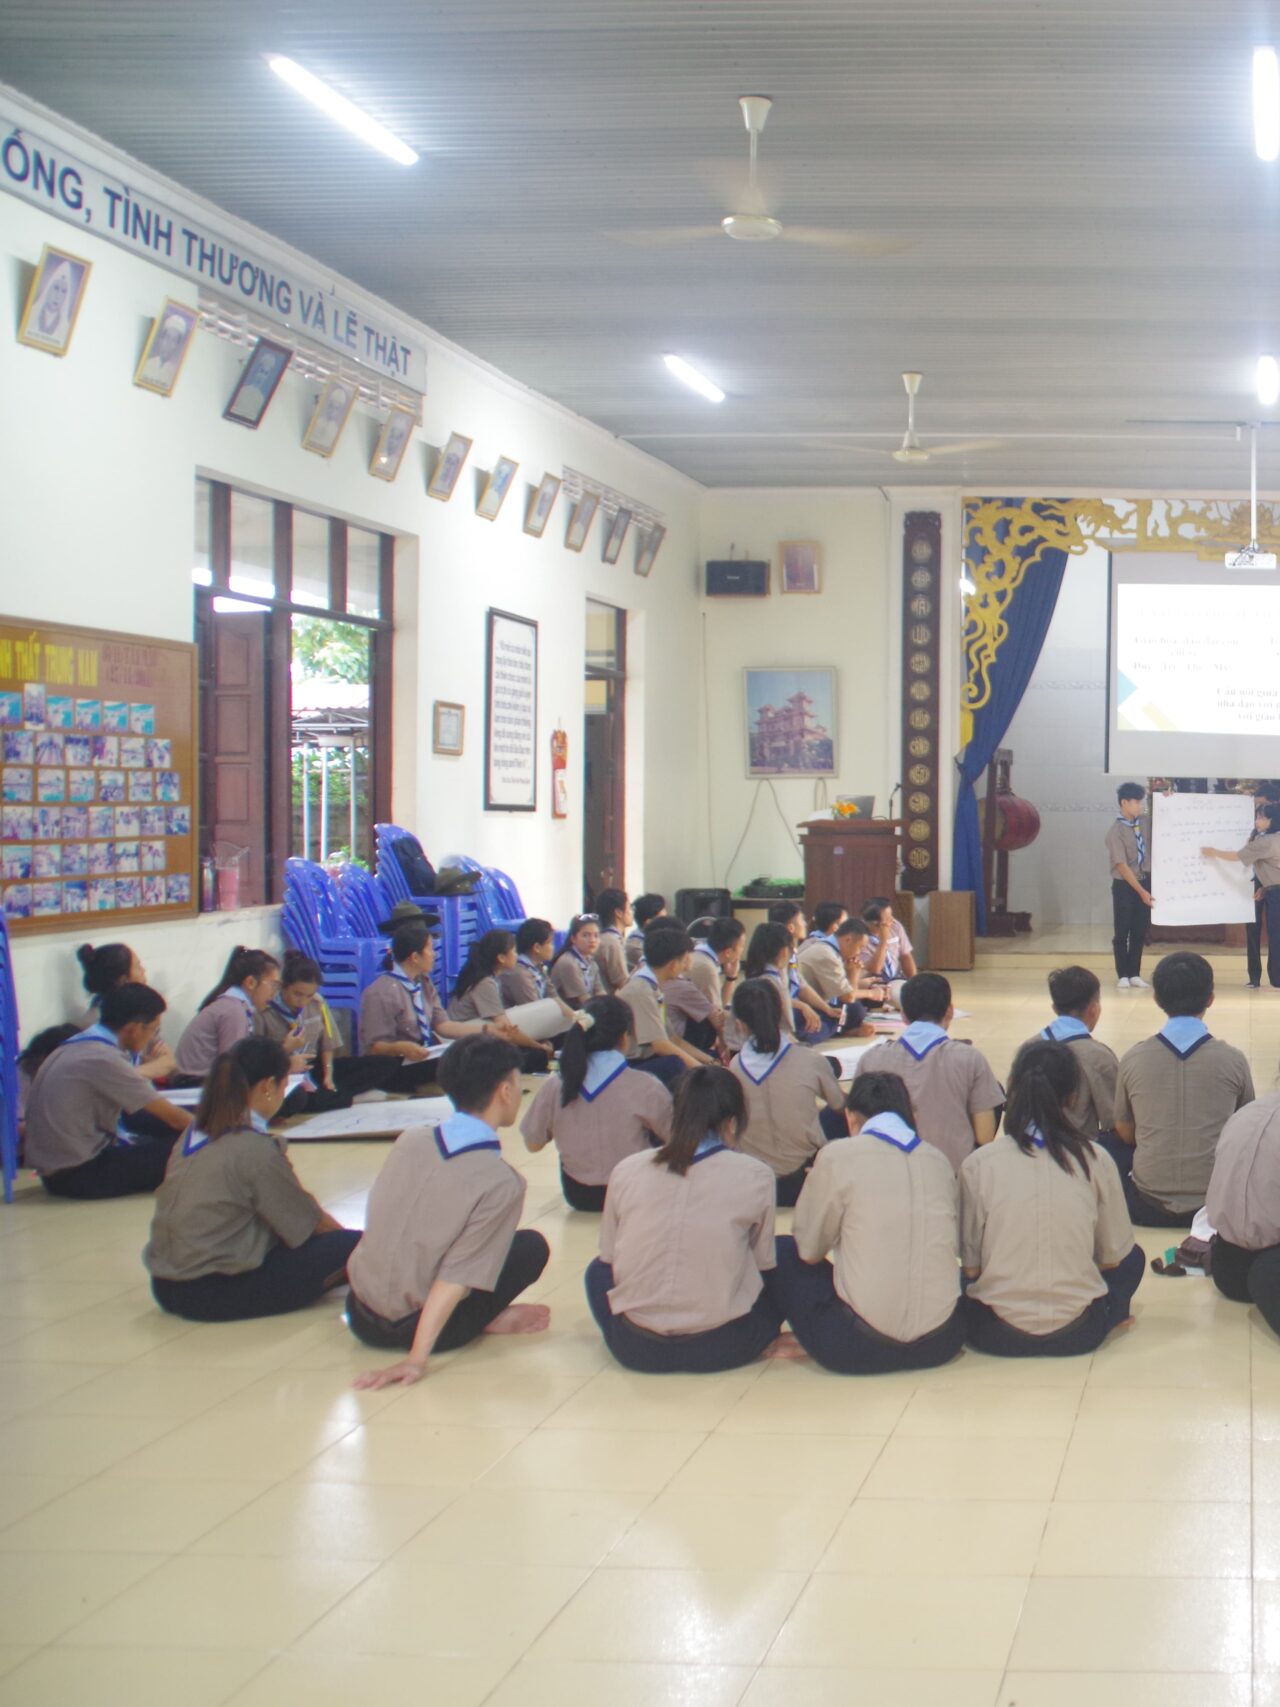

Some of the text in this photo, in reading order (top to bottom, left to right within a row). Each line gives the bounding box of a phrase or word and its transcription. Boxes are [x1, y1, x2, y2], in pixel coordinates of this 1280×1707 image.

[103, 185, 173, 256] TÌNH
[181, 227, 292, 315] THƯƠNG
[298, 289, 327, 334] VÀ
[363, 324, 412, 378] THẬT
